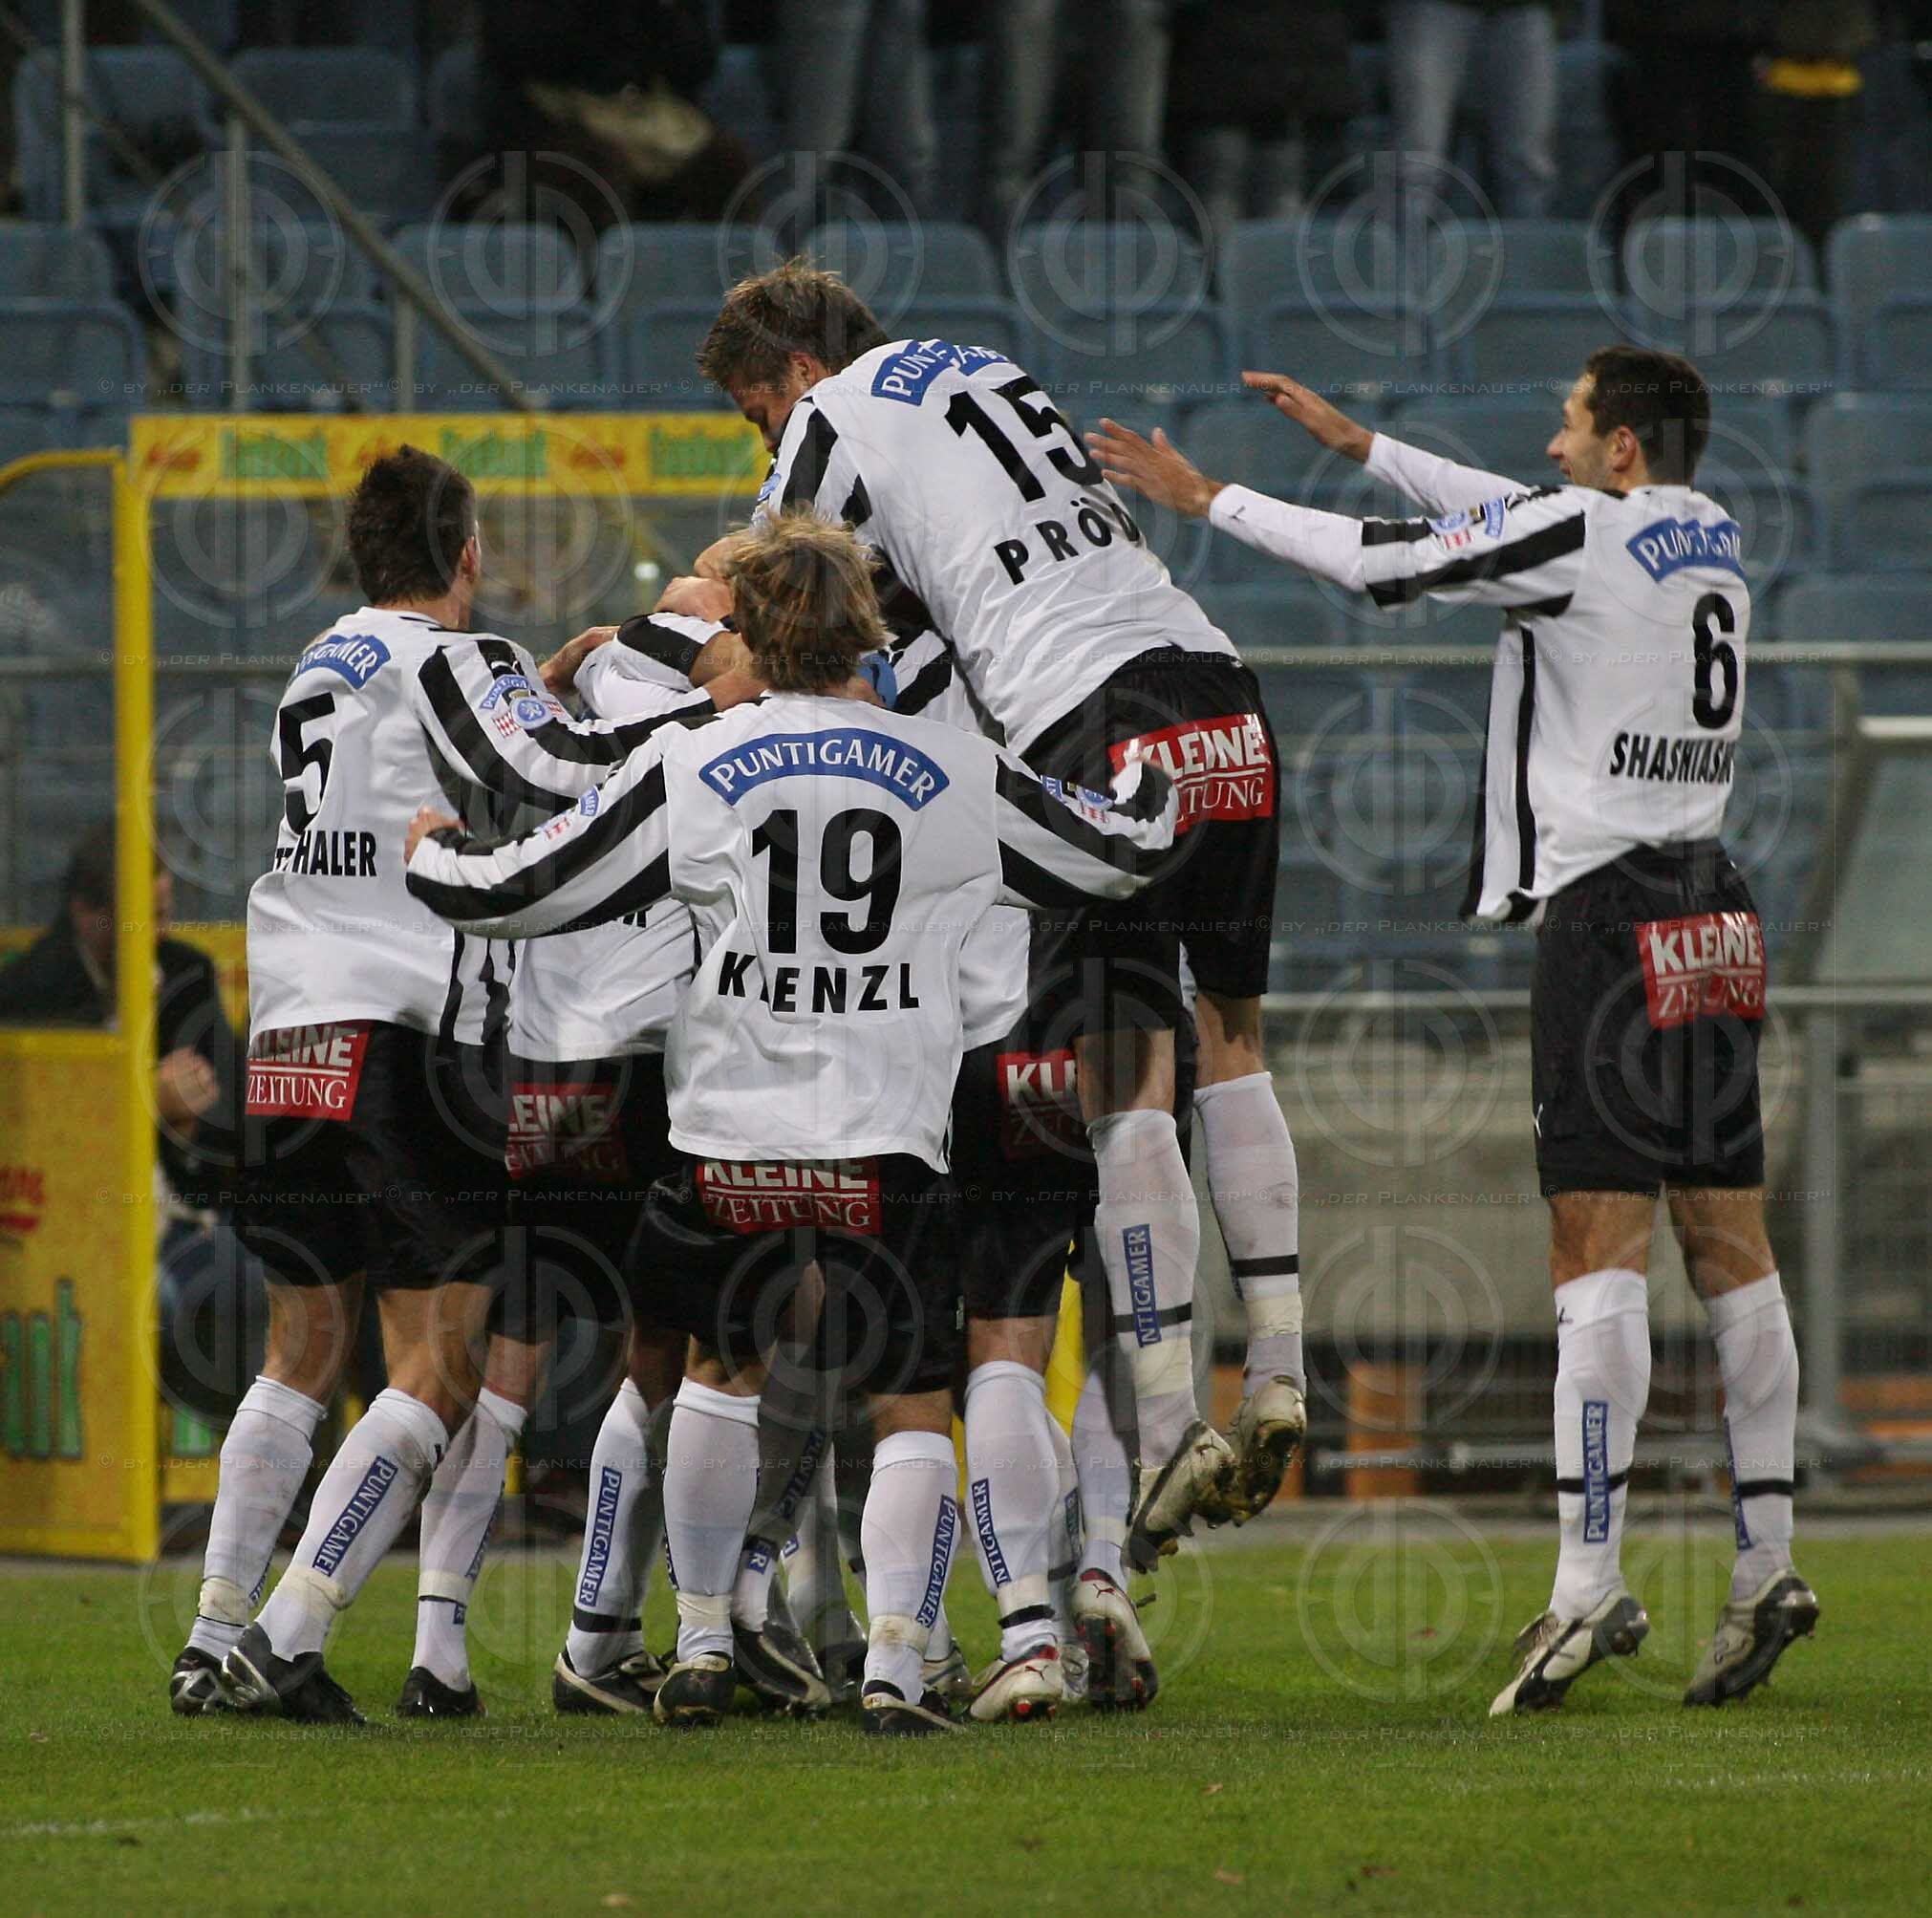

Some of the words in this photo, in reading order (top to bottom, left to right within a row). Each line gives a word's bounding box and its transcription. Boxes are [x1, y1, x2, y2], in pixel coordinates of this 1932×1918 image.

[944, 375, 1104, 503] 15
[1693, 593, 1737, 729] 6
[279, 692, 335, 834] 5
[710, 739, 934, 803] PUNTIGAMER
[751, 808, 902, 955] 19
[718, 951, 919, 1014] KENZL
[1649, 922, 1762, 975] KLEINE
[247, 1075, 347, 1109] ZEITUNG
[509, 1094, 608, 1132] EINE
[713, 1196, 870, 1227] ZEITUNG
[1588, 1404, 1606, 1541] PUNTIGAMER
[579, 1471, 620, 1605] PUNTIGAMER
[917, 1499, 955, 1627] PUNTIGAMER
